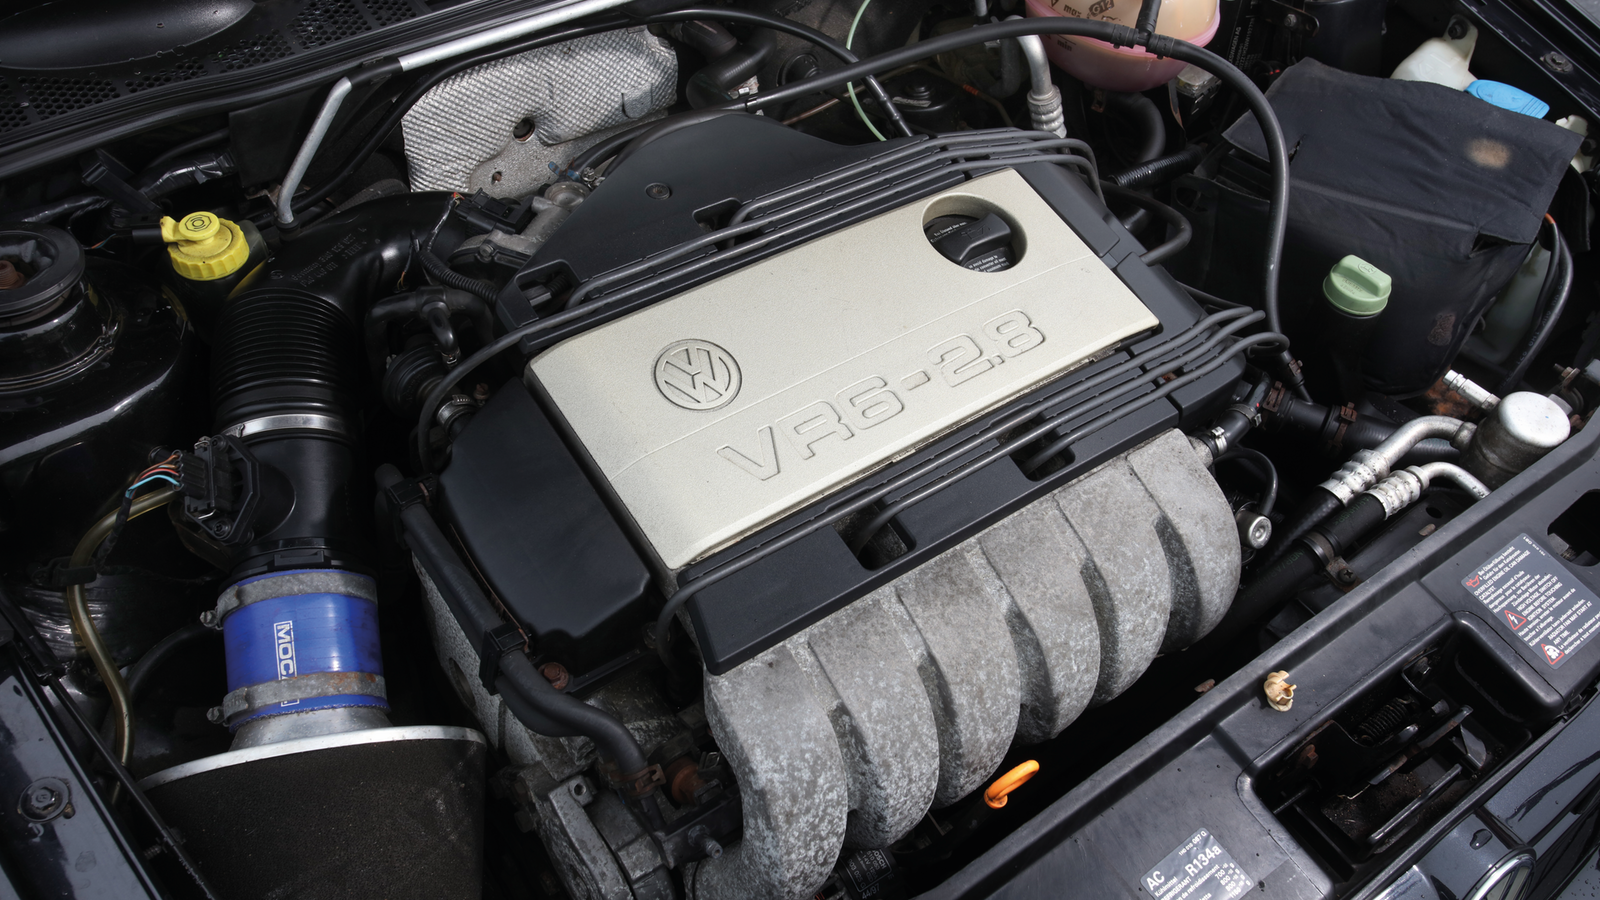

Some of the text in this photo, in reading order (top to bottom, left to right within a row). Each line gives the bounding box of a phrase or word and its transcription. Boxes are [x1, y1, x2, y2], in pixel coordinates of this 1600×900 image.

[1092, 0, 1111, 13] G12
[1057, 40, 1073, 52] min
[1228, 36, 1239, 64] KSWAGEN
[1235, 26, 1242, 36] AG
[1474, 579, 1494, 596] OVERFILLED
[1492, 570, 1505, 581] ENGINE
[1515, 550, 1531, 562] DAMAGE
[1516, 603, 1527, 611] HIGH
[1538, 581, 1553, 593] SWITCH
[1522, 582, 1563, 616] ENGINE BEFORE TOUCHING
[1527, 608, 1543, 621] IGNITION
[1547, 625, 1565, 640] RADIATOR
[1569, 613, 1579, 621] MAY
[1576, 605, 1588, 615] START
[872, 850, 887, 868] OSCH
[1185, 846, 1222, 877] R134a
[1146, 870, 1165, 890] AC
[1186, 864, 1220, 893] refroidissement
[1215, 869, 1226, 879] 700
[860, 882, 880, 899] 44/97
[1154, 876, 1178, 897] Kühlmittel
